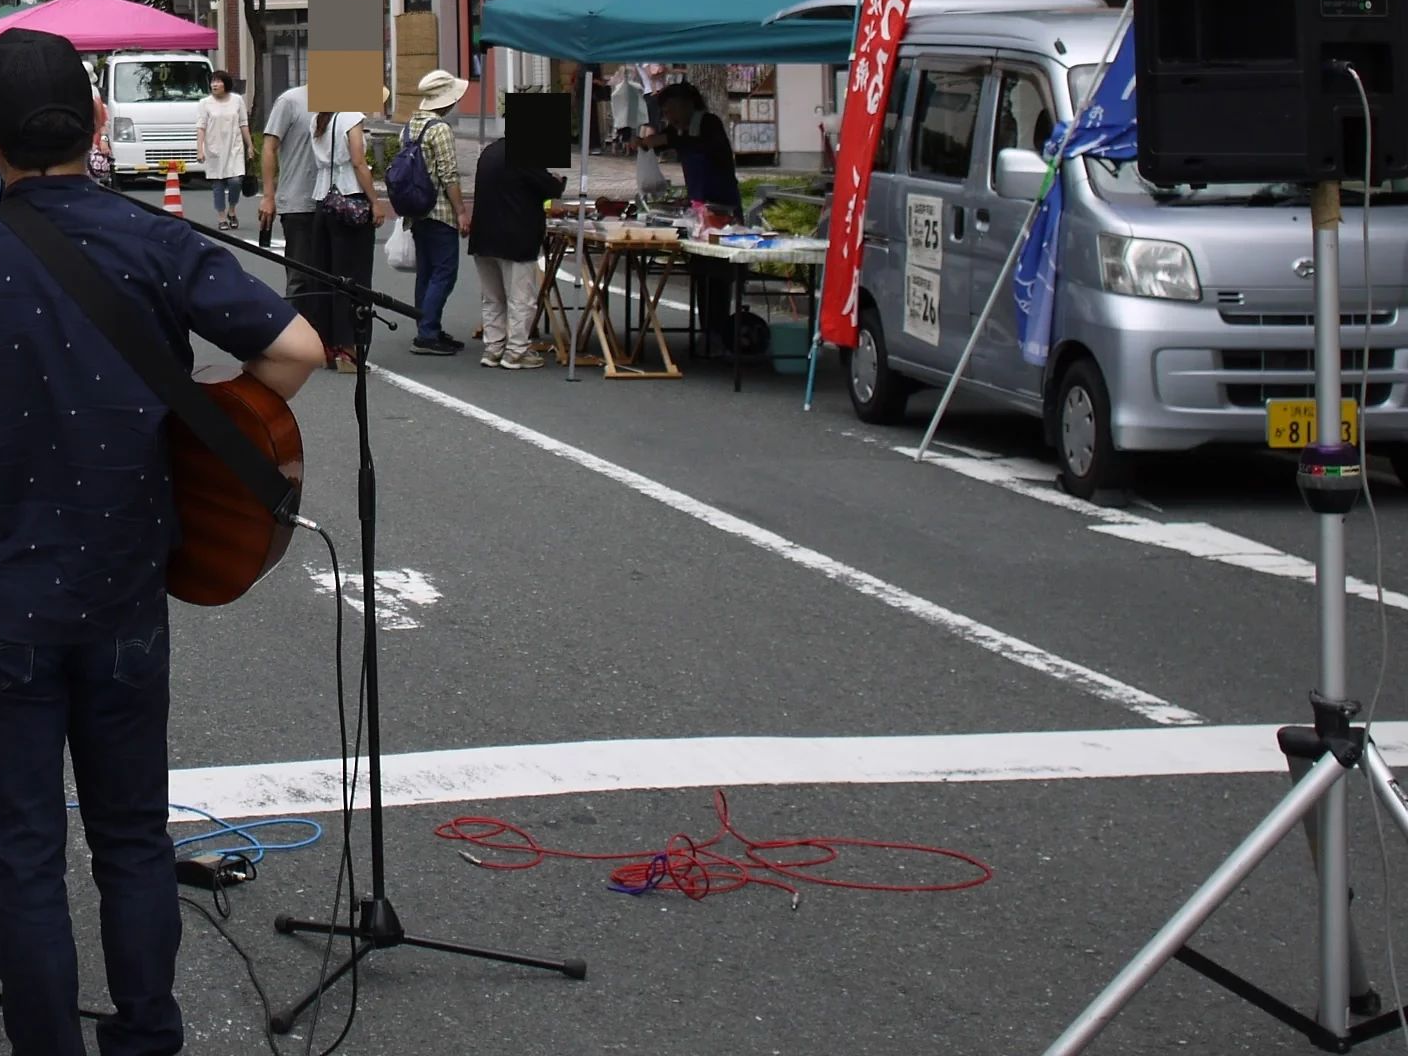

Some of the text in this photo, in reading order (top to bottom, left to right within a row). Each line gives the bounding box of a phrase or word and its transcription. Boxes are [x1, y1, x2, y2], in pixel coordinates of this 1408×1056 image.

[924, 219, 938, 250] 25
[922, 293, 936, 325] 26
[1288, 421, 1352, 443] 813
